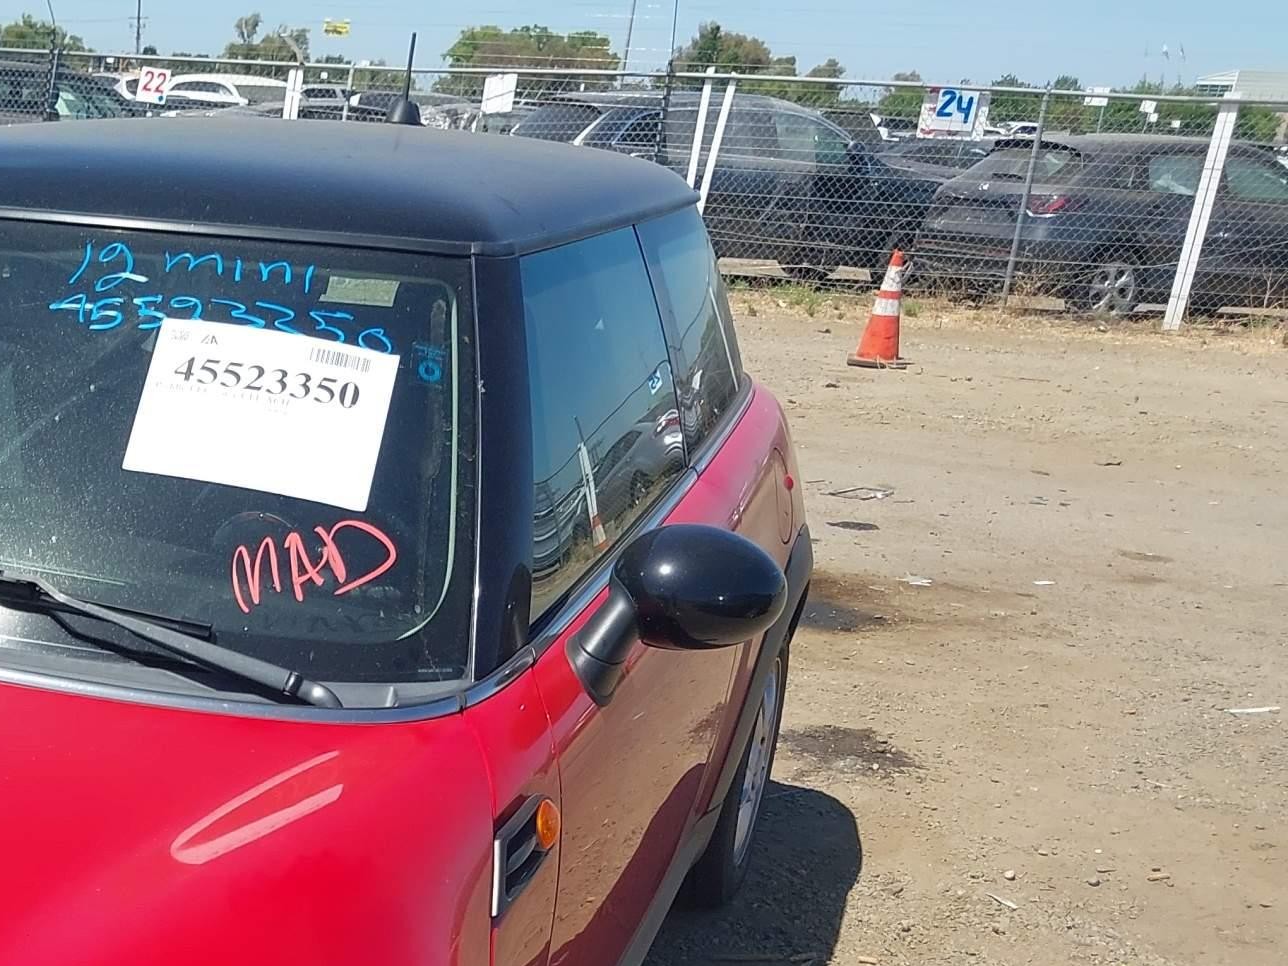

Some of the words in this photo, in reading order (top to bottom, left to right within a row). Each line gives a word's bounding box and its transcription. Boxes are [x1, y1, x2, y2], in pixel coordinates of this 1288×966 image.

[141, 70, 167, 94] 22
[936, 89, 974, 124] 24
[68, 241, 149, 292] 12
[173, 355, 360, 409] 45523350
[231, 519, 397, 614] MAD
